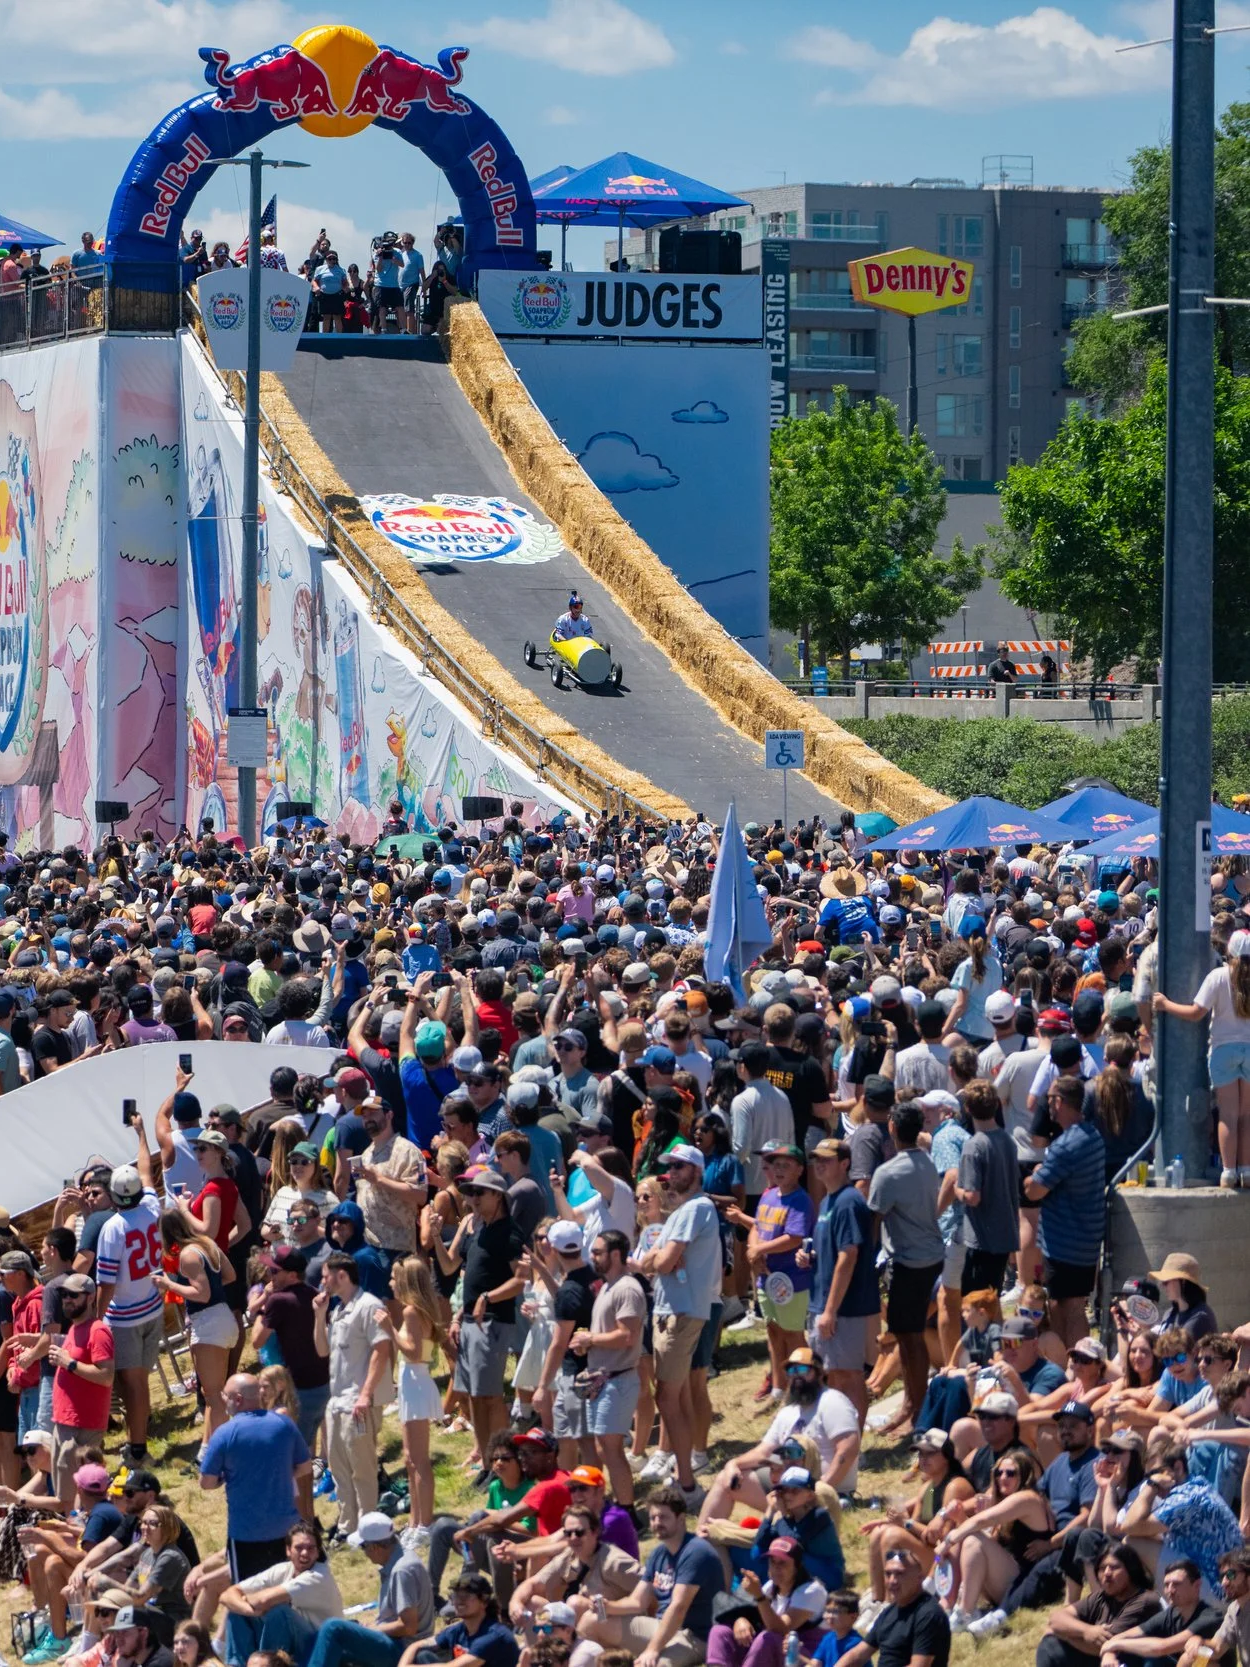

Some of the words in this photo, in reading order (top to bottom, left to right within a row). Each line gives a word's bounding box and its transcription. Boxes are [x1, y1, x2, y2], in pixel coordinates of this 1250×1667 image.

[140, 179, 180, 237] Red
[162, 133, 210, 189] Bull
[468, 141, 514, 198] Red
[492, 194, 523, 246] Bull
[604, 186, 642, 195] Red
[643, 186, 678, 196] Bull
[864, 261, 967, 298] Denny's
[524, 296, 541, 306] Red
[542, 296, 560, 307] Bull
[577, 280, 723, 329] JUDGES
[767, 273, 785, 367] LEASING
[380, 521, 448, 534] Red
[449, 522, 516, 535] Bull
[408, 534, 506, 544] SOAPBOX
[437, 544, 493, 554] RACE
[5, 560, 27, 615] Bull
[670, 828, 681, 838] 10
[1092, 824, 1118, 832] Red
[988, 833, 1015, 842] Red
[1016, 832, 1041, 840] Bull
[1217, 843, 1243, 851] Red
[1129, 924, 1139, 933] 10
